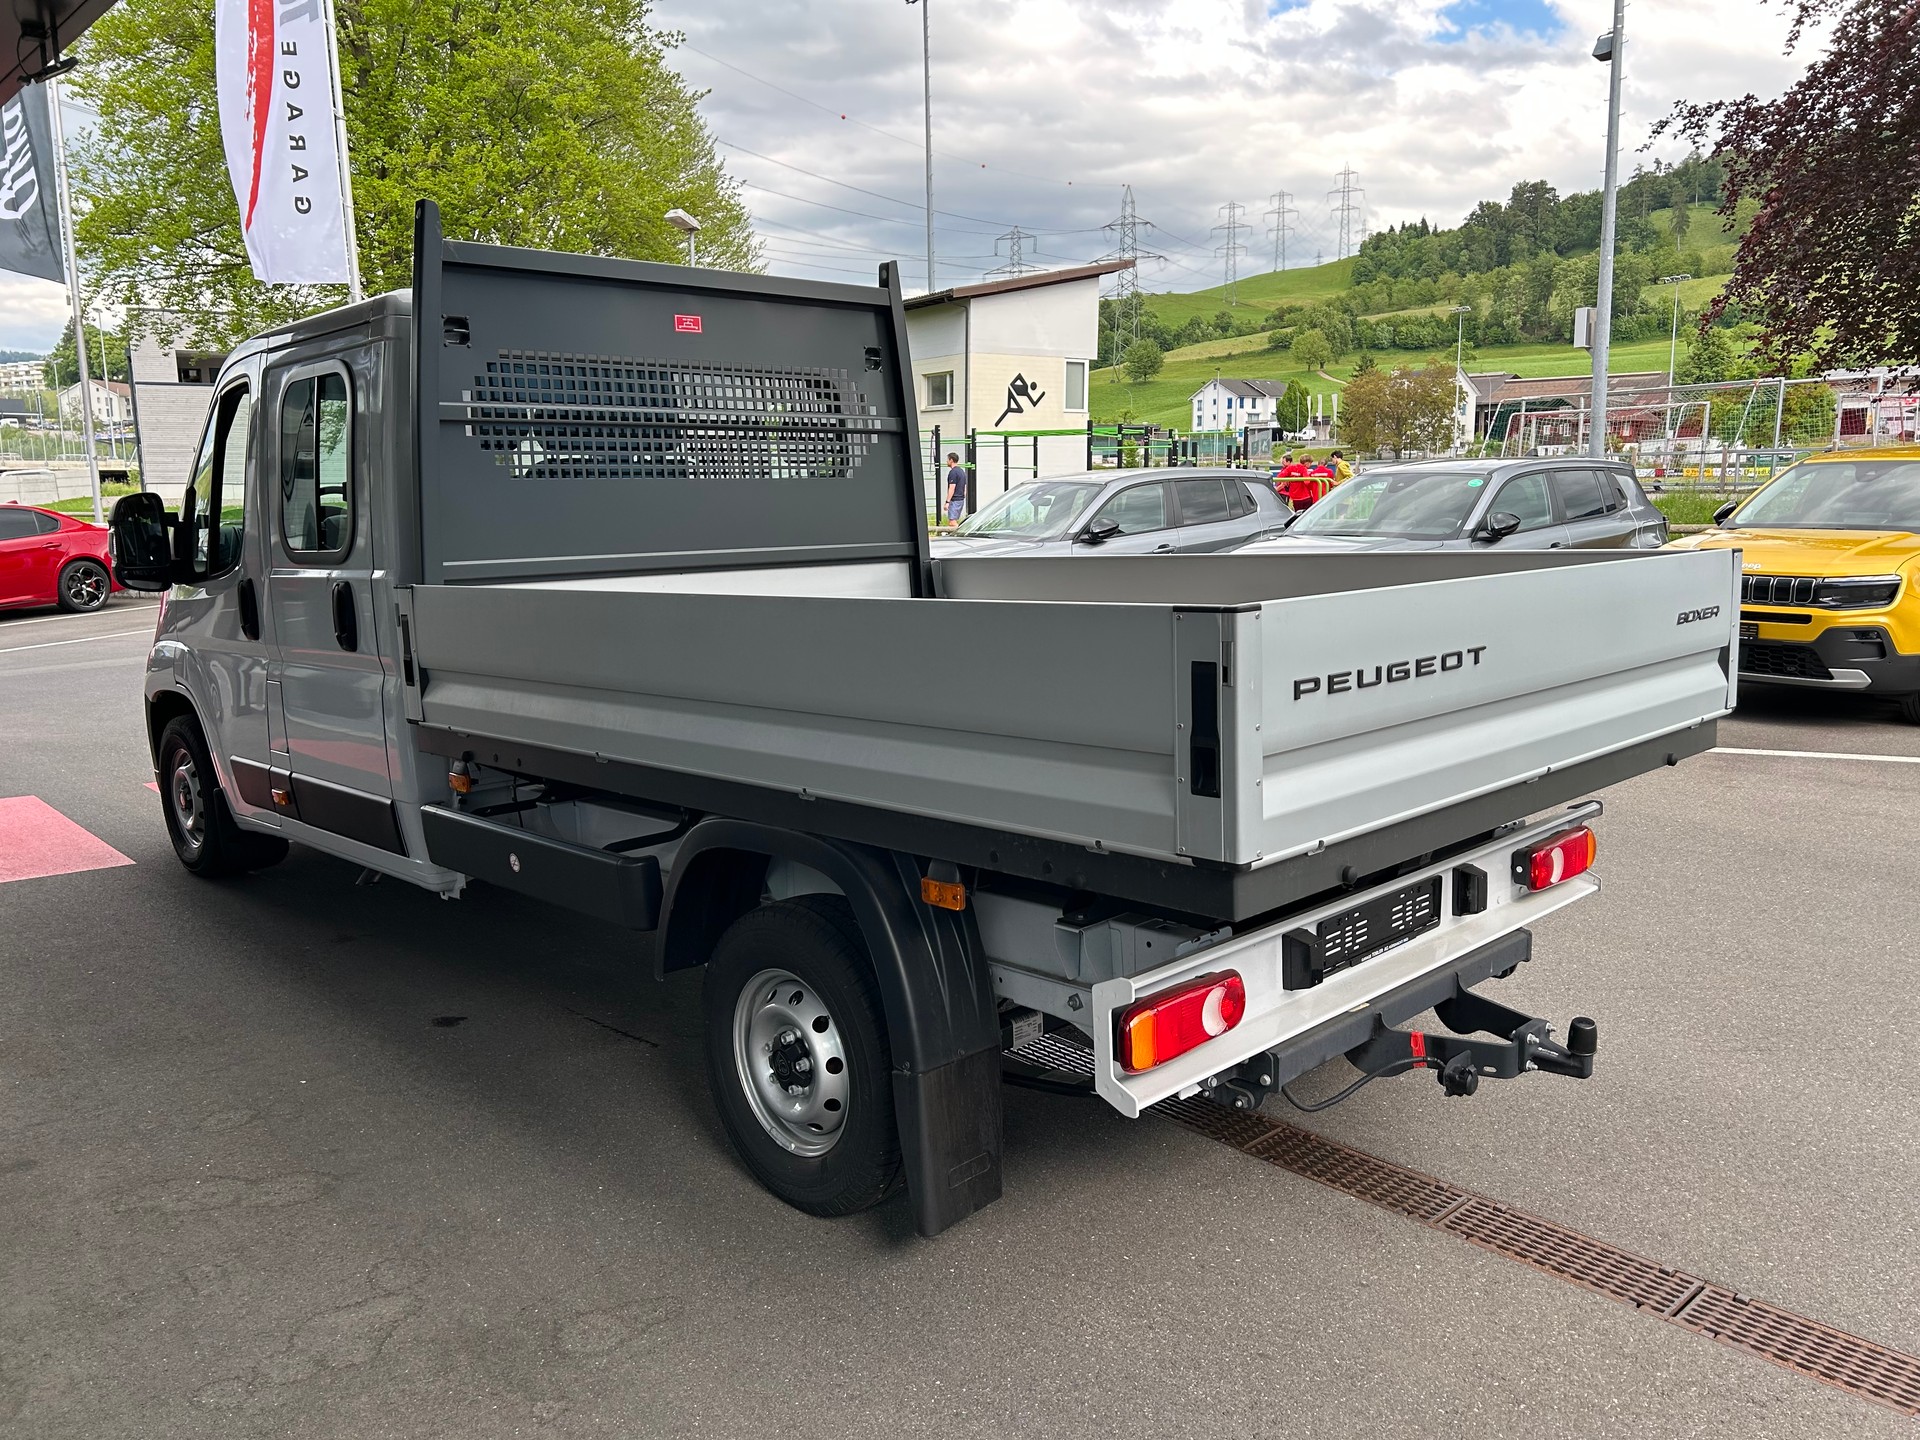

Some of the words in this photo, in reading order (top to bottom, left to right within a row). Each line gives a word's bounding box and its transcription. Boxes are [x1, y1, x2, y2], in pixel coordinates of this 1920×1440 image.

[1741, 562, 1761, 570] eep
[1676, 605, 1720, 625] BOXER
[1293, 645, 1487, 701] PEUGEOT
